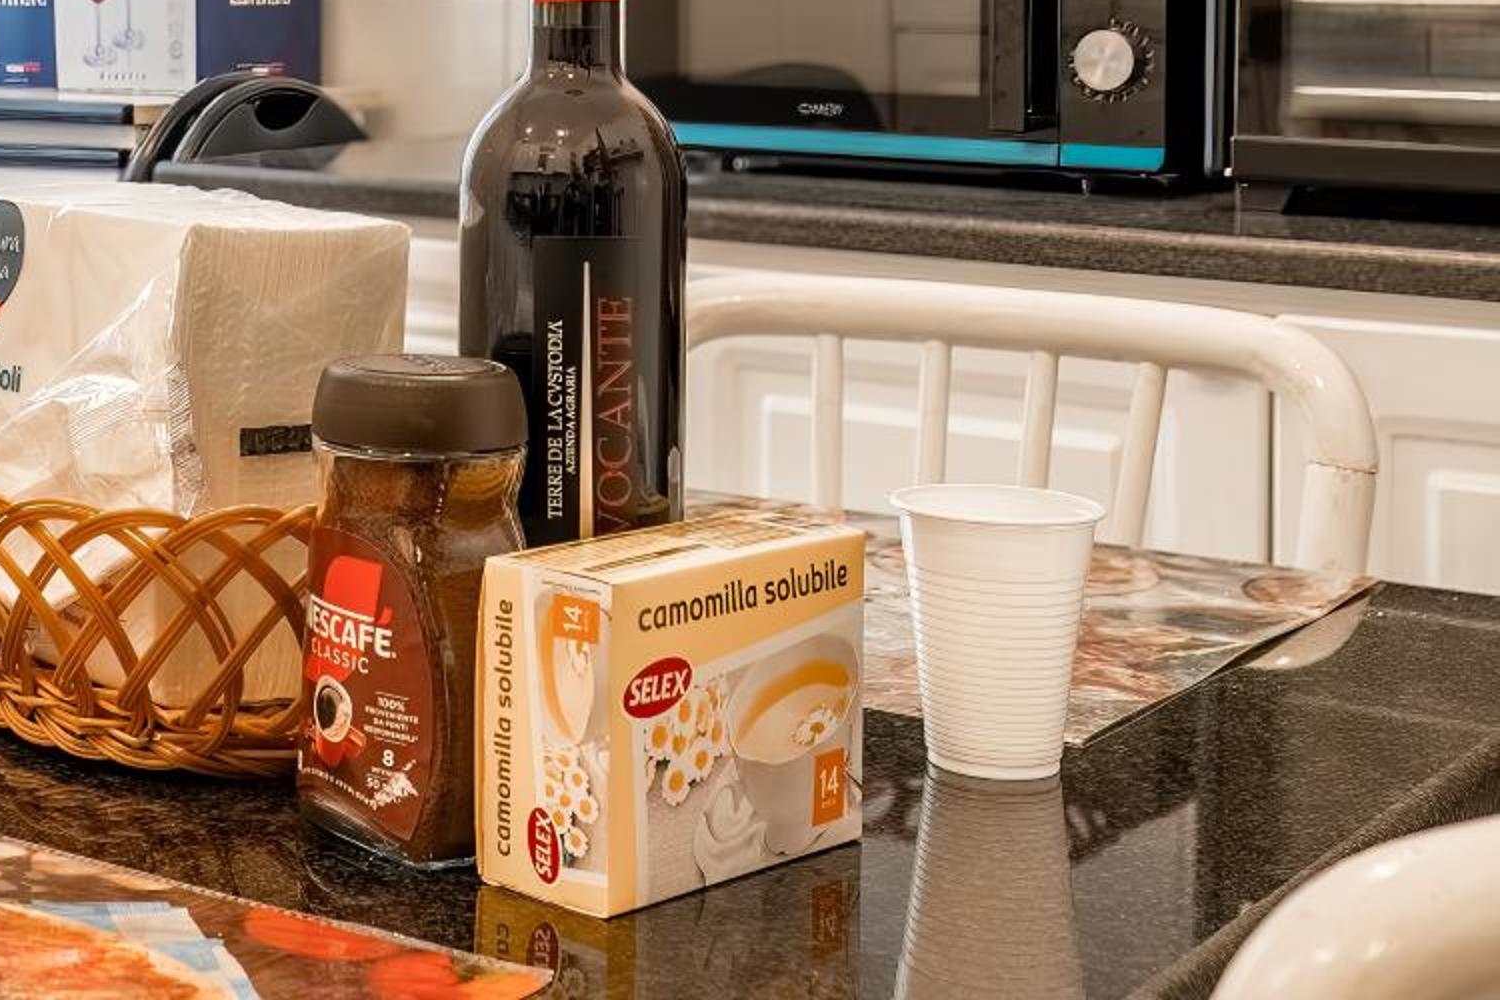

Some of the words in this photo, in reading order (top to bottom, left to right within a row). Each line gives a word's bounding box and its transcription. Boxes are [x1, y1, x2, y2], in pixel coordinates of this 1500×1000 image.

[565, 365, 577, 419] AGRARIA
[546, 409, 563, 431] LA
[546, 438, 563, 461] DE
[565, 421, 577, 475] AZIENDA
[546, 464, 563, 520] TERRE
[563, 605, 583, 632] 14
[637, 579, 757, 632] camomilla
[764, 559, 848, 605] solubile
[311, 636, 369, 674] CLASSIC
[493, 599, 513, 709] solubile
[629, 667, 689, 707] SELEX
[382, 749, 395, 767] 8
[493, 716, 512, 857] camomilla
[819, 764, 840, 800] 14
[535, 811, 553, 879] SELEX
